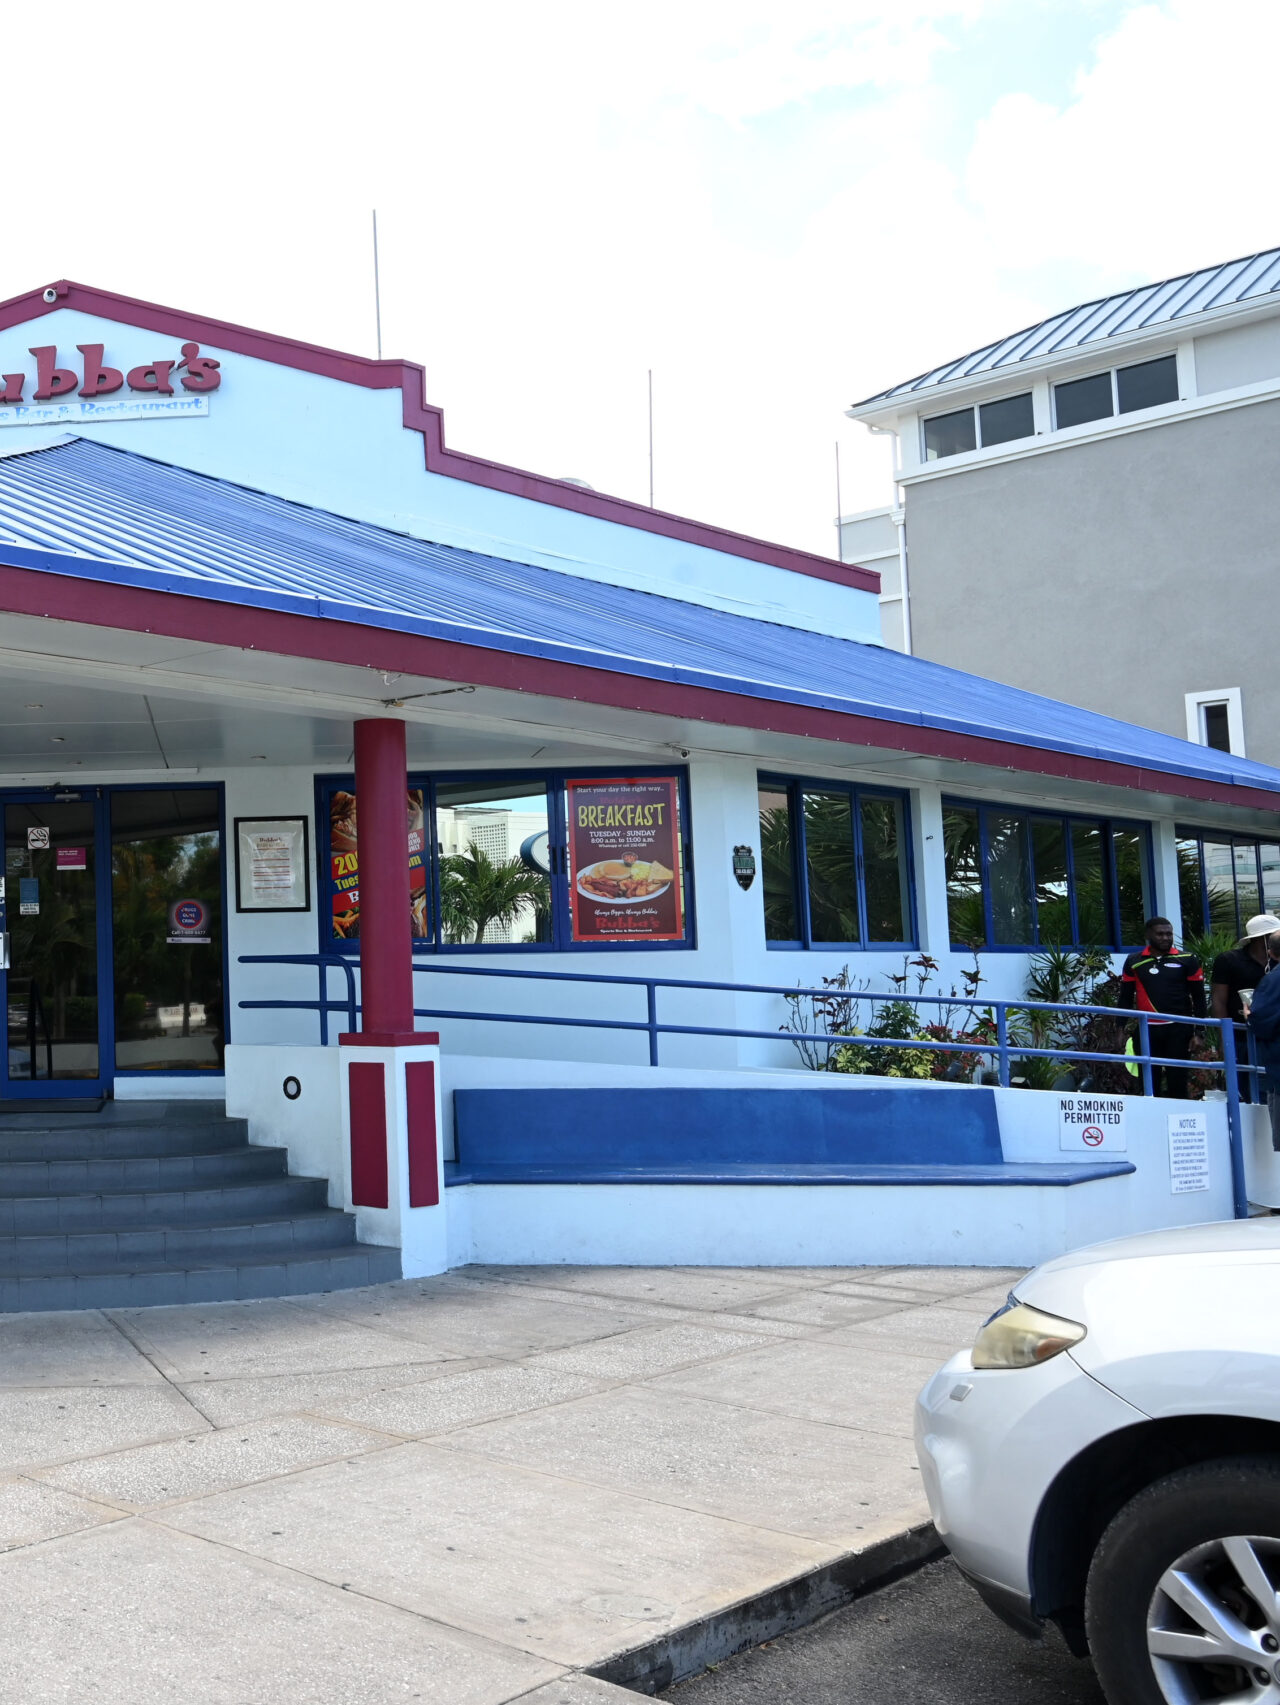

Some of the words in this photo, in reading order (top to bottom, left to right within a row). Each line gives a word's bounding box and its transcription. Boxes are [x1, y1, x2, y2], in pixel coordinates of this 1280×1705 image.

[14, 406, 54, 420] Bar
[79, 398, 203, 416] Restaurant
[578, 803, 666, 828] BREAKFAST
[334, 850, 359, 876] 20
[334, 874, 359, 891] Tues
[595, 916, 661, 929] Bubba's
[1060, 1099, 1074, 1111] NO
[1077, 1100, 1124, 1112] SMOKING
[1064, 1112, 1121, 1125] PERMITTED
[1178, 1118, 1197, 1129] NOTICE
